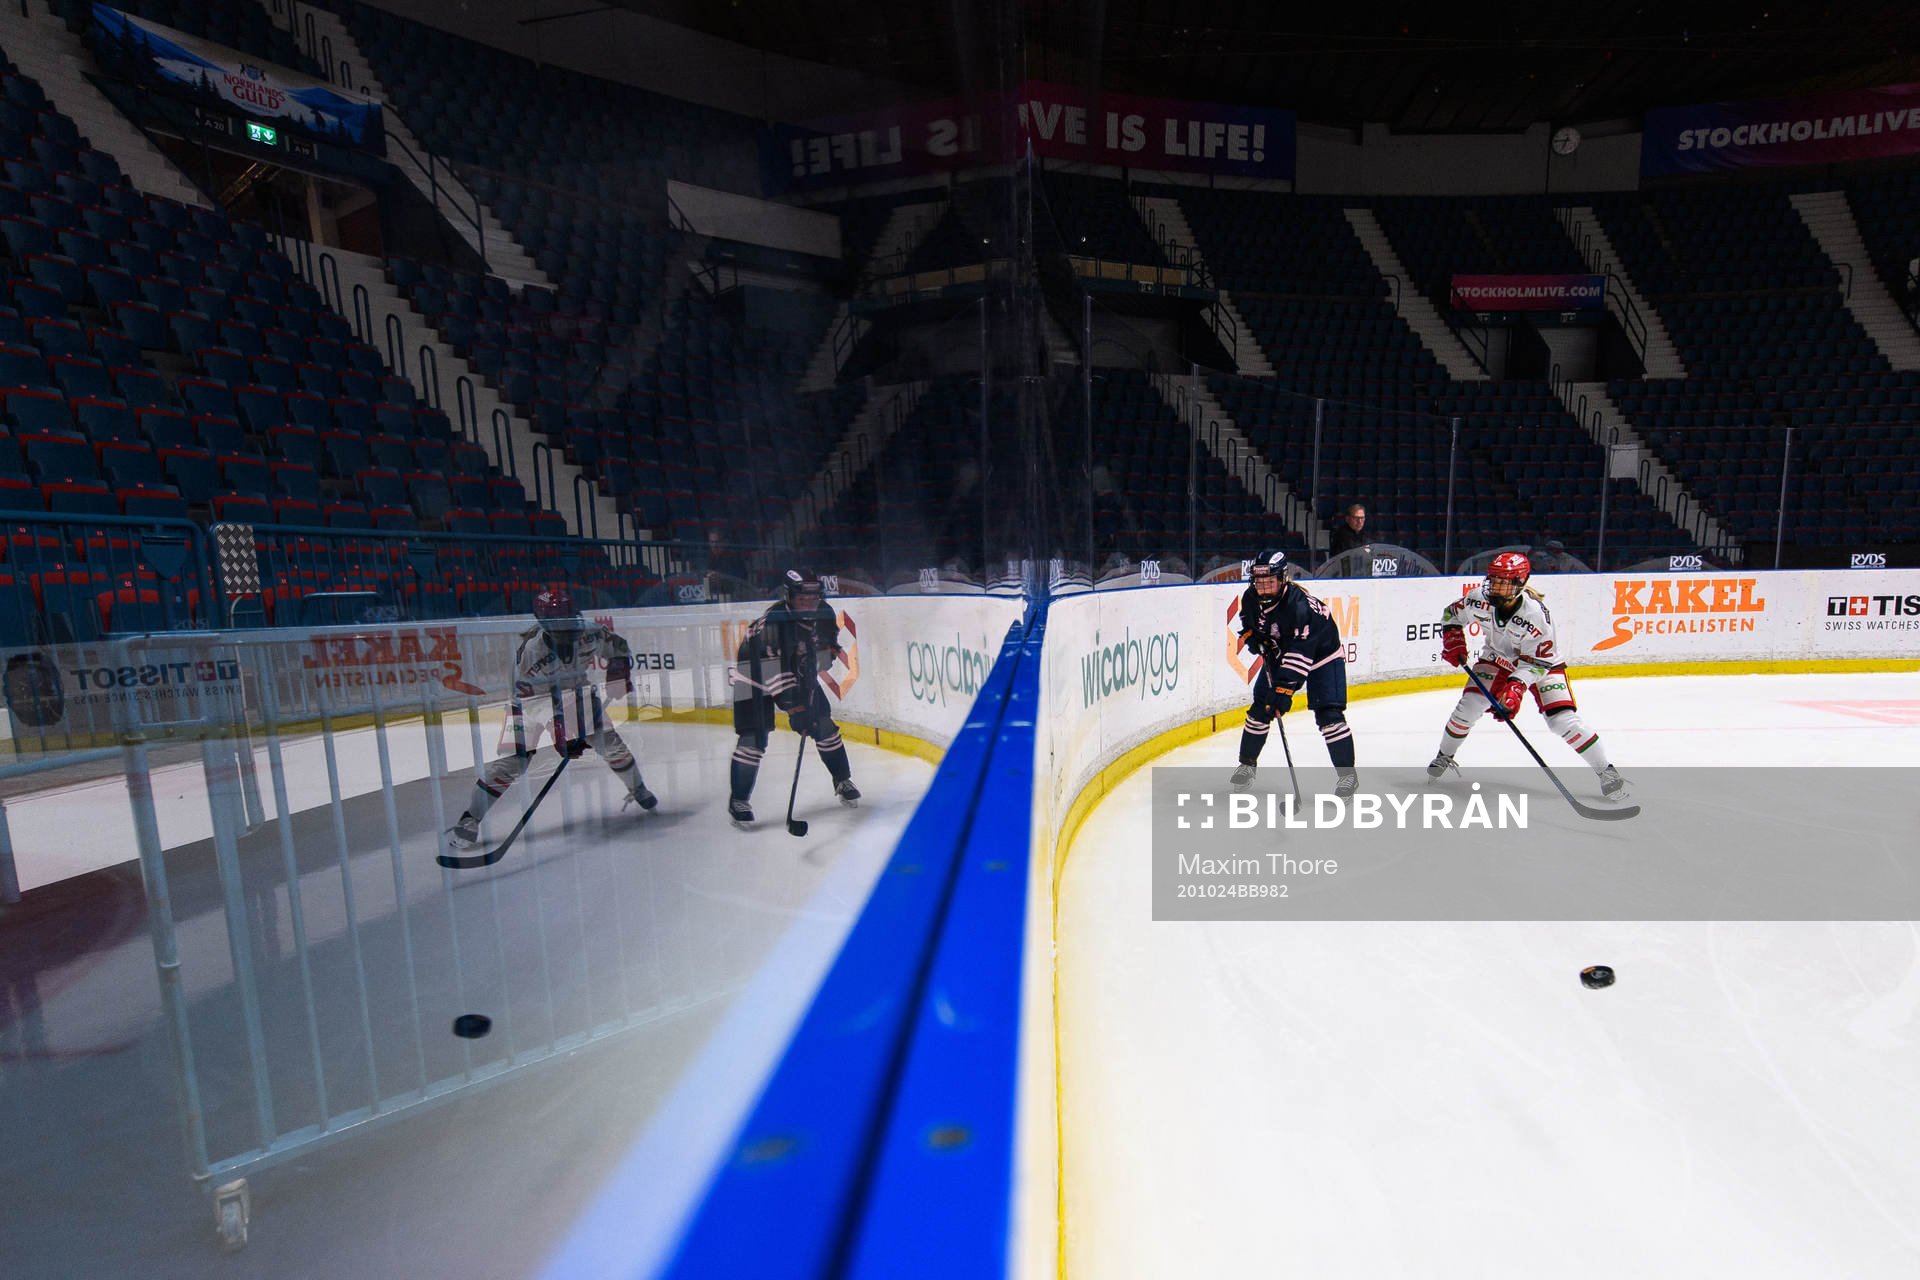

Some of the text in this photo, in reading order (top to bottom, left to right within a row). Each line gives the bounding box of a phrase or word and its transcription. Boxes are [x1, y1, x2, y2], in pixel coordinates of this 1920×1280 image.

[223, 72, 286, 102] NORRLANDS
[232, 85, 280, 109] GULD
[1105, 111, 1147, 152] IS
[1163, 117, 1266, 163] LIFE!
[1677, 107, 1920, 151] STOCKHOLMLIVE
[1456, 285, 1601, 298] STOCKHOLMLIVE.COM
[1372, 558, 1398, 572] RYDS
[1669, 555, 1703, 568] RYDS
[1851, 553, 1887, 566] RYDS
[1612, 579, 1766, 615] KAKEL
[1590, 615, 1755, 652] SPECIALISTEN
[1825, 620, 1920, 631] SWISS WATCHES
[1081, 625, 1179, 709] wicabygg
[1540, 682, 1567, 694] coop
